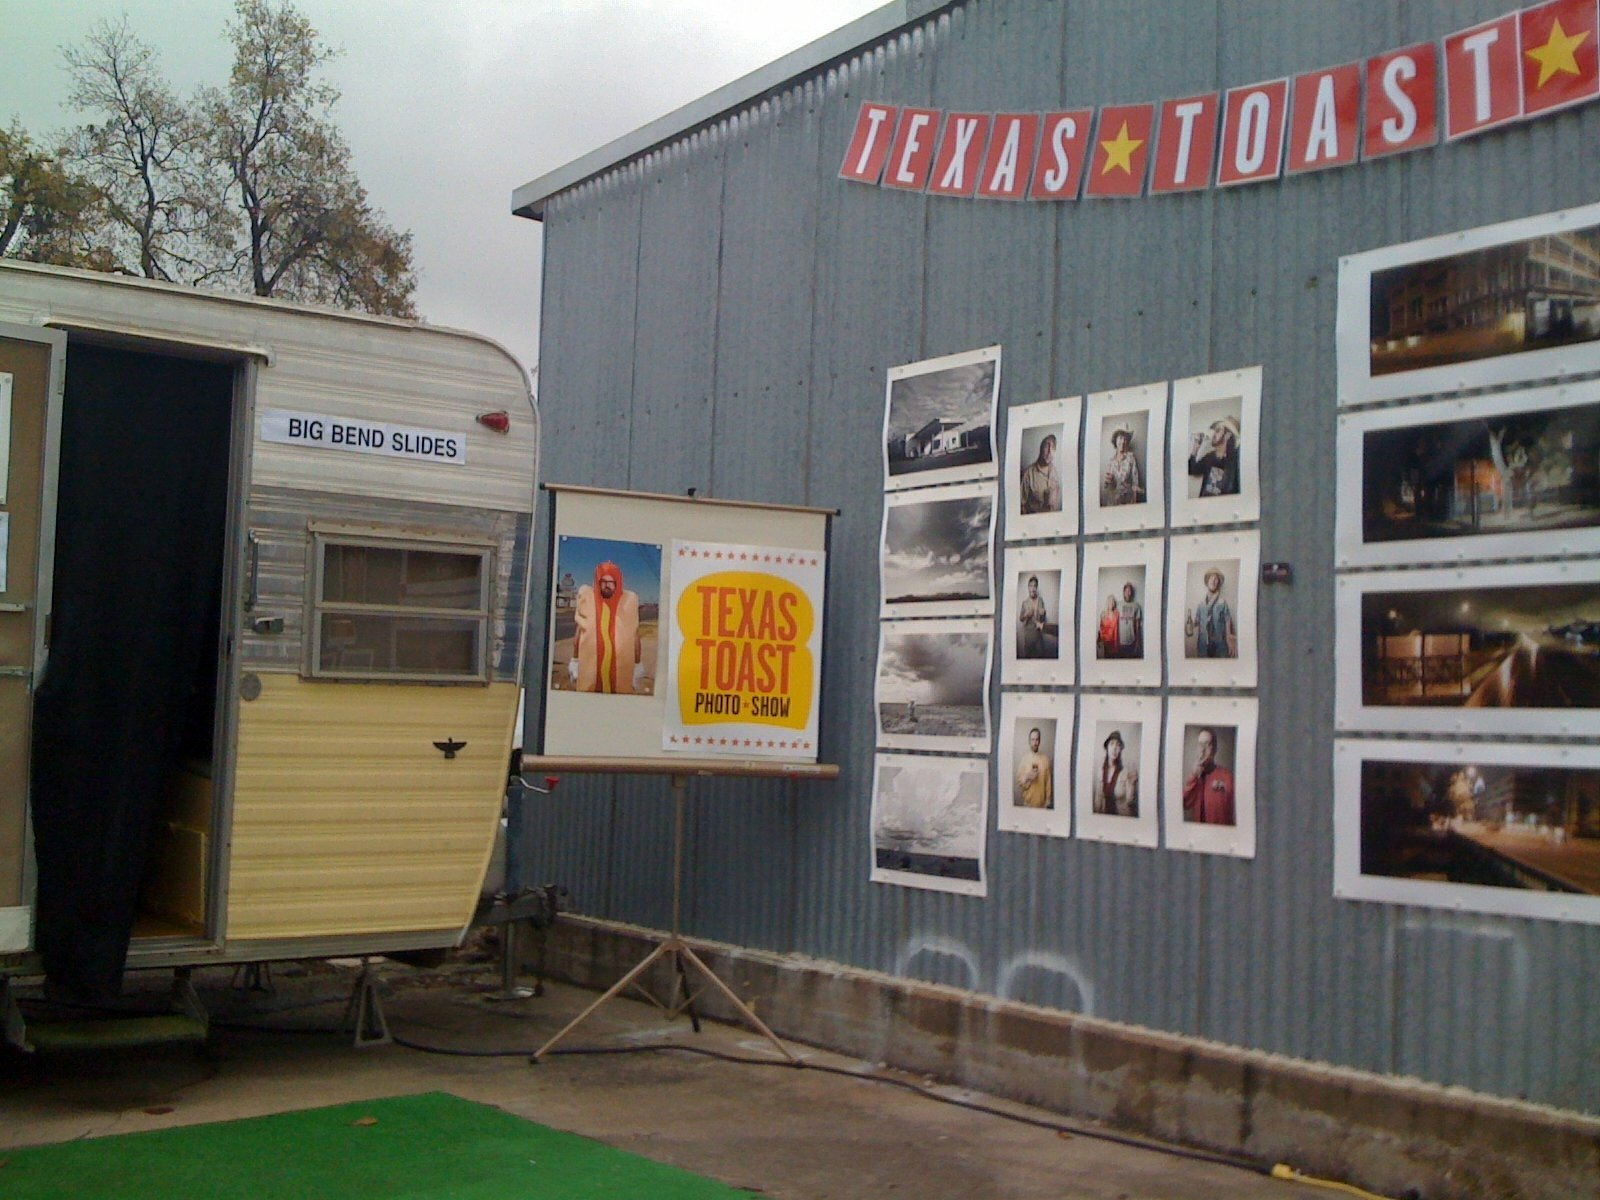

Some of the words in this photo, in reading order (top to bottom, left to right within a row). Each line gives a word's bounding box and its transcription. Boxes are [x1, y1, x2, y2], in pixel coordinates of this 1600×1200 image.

[855, 108, 1077, 192] TEXAS
[1173, 28, 1499, 184] TOAST
[288, 418, 323, 440] BIG
[331, 424, 385, 448] BEND
[391, 432, 457, 458] SLIDES
[696, 586, 798, 641] TEXAS
[695, 639, 796, 694] TOAST
[695, 692, 740, 715] PHOTO
[751, 696, 791, 718] SHOW
